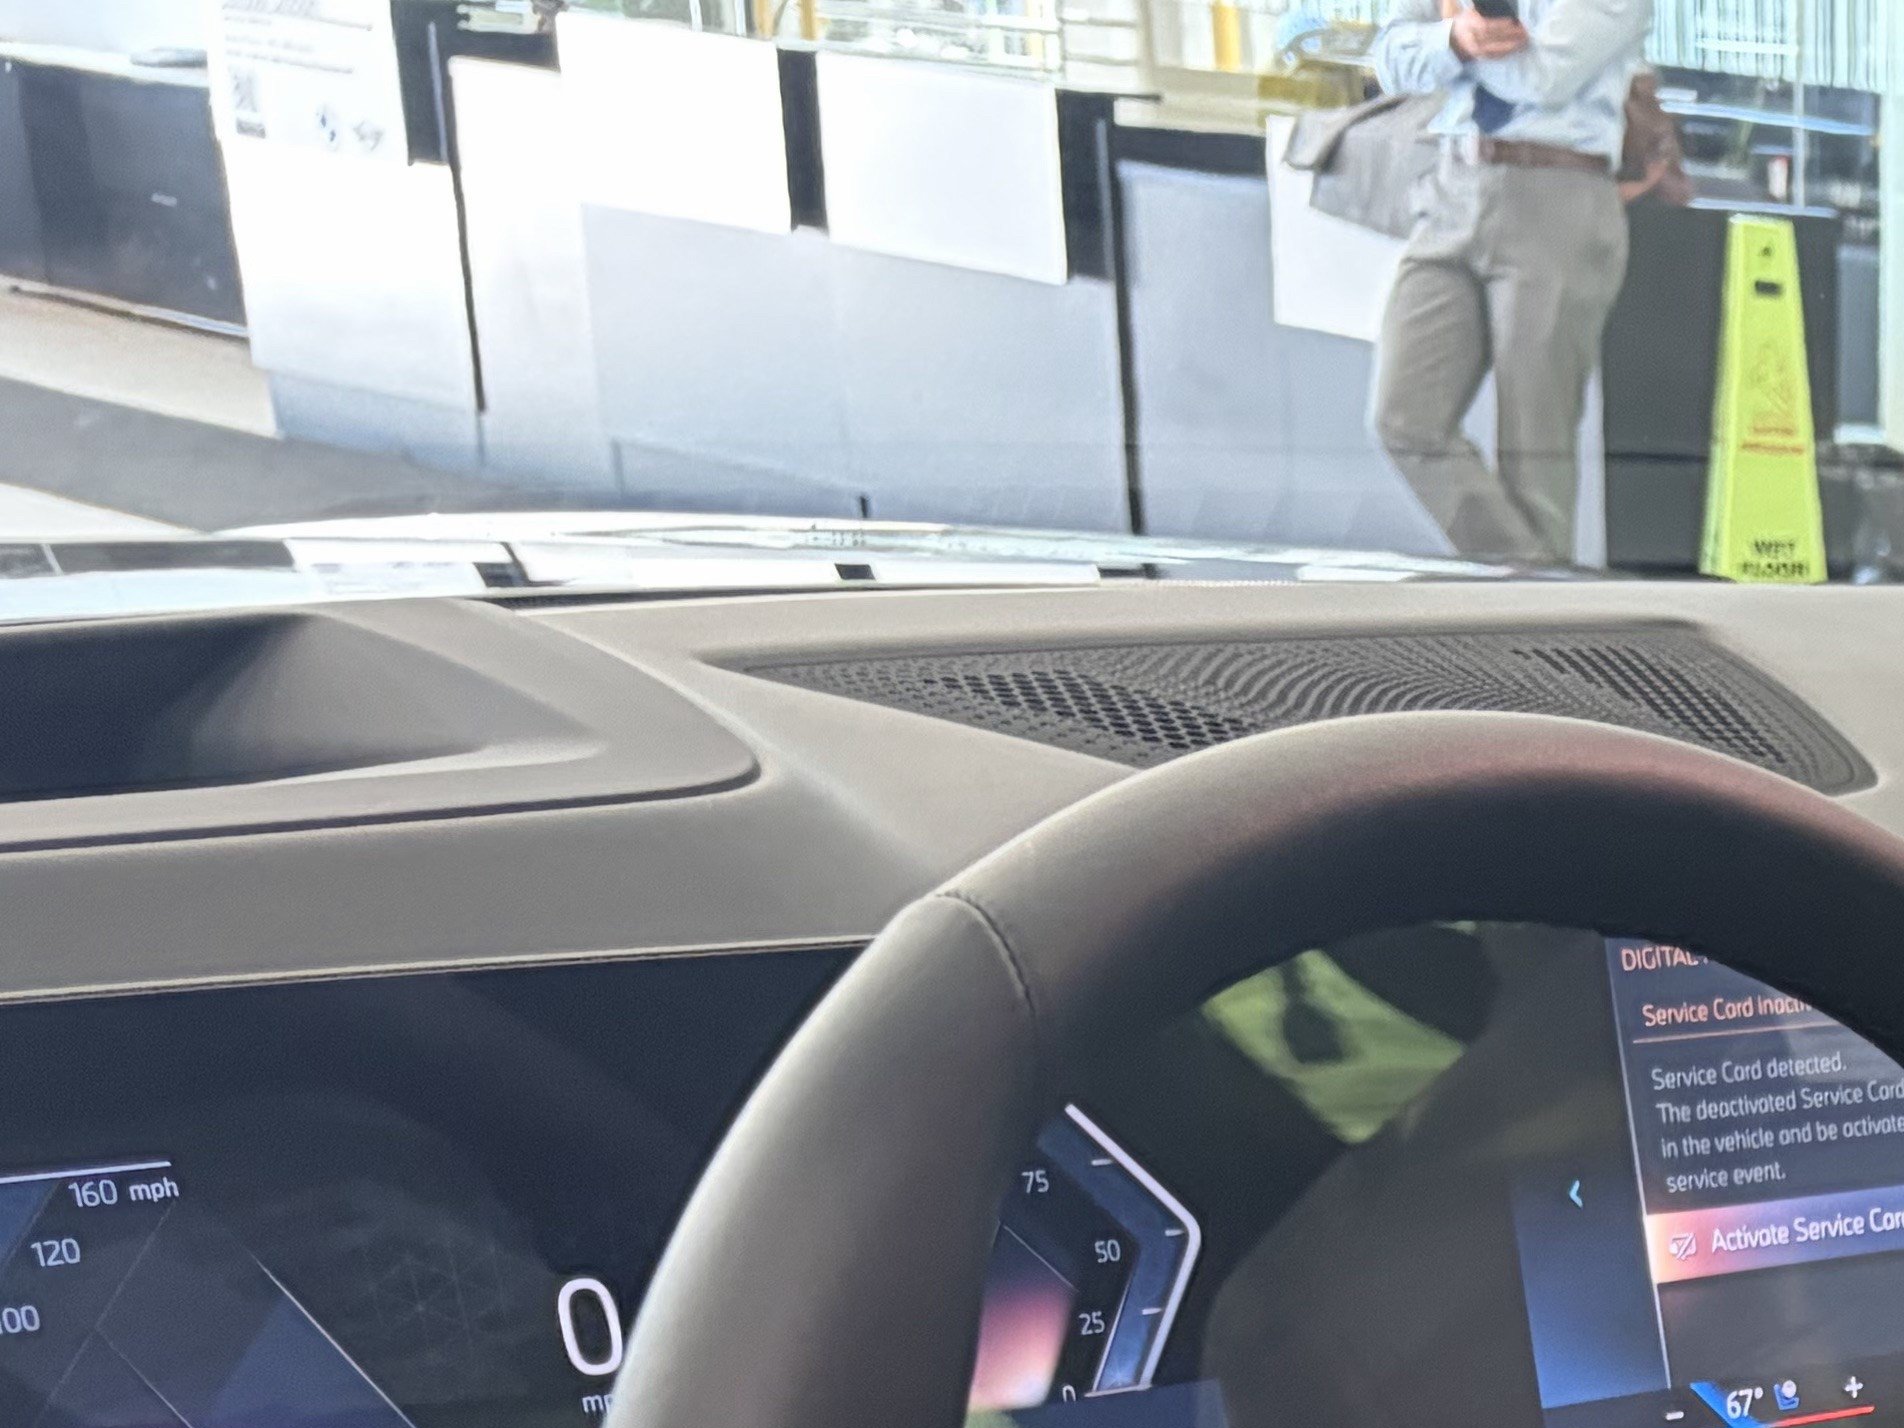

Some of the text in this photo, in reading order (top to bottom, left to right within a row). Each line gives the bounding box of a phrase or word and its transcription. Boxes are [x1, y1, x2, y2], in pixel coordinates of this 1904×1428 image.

[1753, 538, 1797, 560] WET
[1642, 1003, 1708, 1027] Service
[1713, 996, 1754, 1021] Card
[1651, 1050, 1848, 1090] Service Card detected.
[1656, 1100, 1691, 1125] The
[1695, 1093, 1797, 1120] deactivated
[1801, 1086, 1863, 1109] Service
[1661, 1137, 1678, 1159] in
[1682, 1130, 1711, 1156] the
[1714, 1123, 1774, 1150] vehicle
[1778, 1121, 1812, 1145] and
[1816, 1118, 1838, 1141] be
[68, 1176, 180, 1208] 160 mph
[1021, 1170, 1050, 1195] 75
[1666, 1161, 1787, 1194] service event.
[1711, 1220, 1790, 1254] Activate
[1794, 1213, 1865, 1244] Service
[30, 1237, 81, 1268] 120
[1093, 1239, 1122, 1264] 50
[0, 1304, 41, 1335] 00
[557, 1277, 623, 1376] 0
[1078, 1311, 1106, 1337] 25
